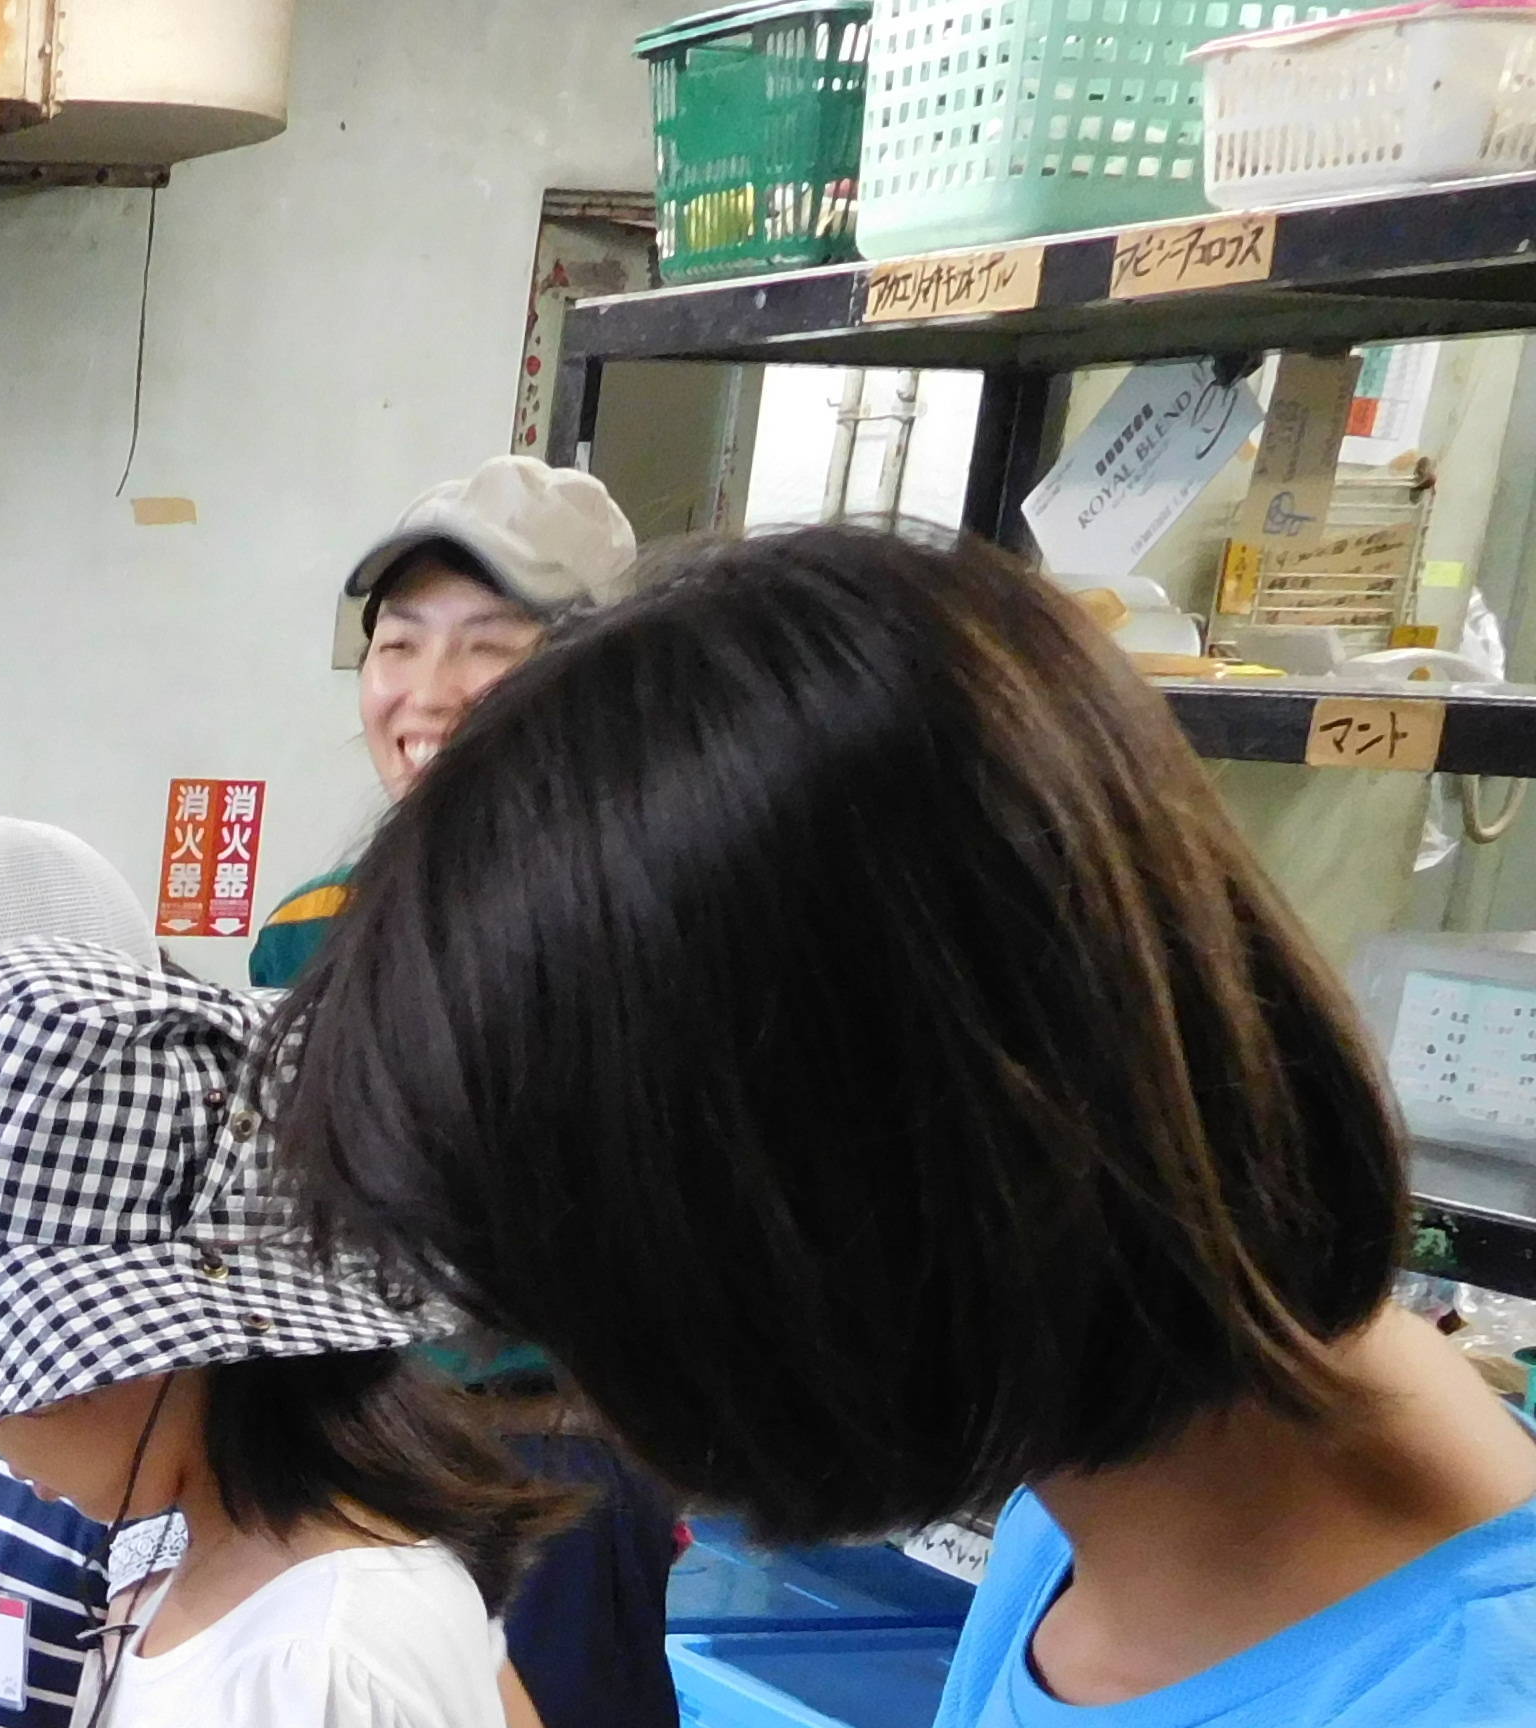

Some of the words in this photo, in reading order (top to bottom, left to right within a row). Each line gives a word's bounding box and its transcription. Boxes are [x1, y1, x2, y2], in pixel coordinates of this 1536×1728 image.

[1077, 462, 1137, 530] ROYAL
[1134, 389, 1193, 463] BLEND
[1320, 711, 1409, 760] マント
[167, 784, 210, 899] 消火器
[213, 784, 258, 899] 消火器
